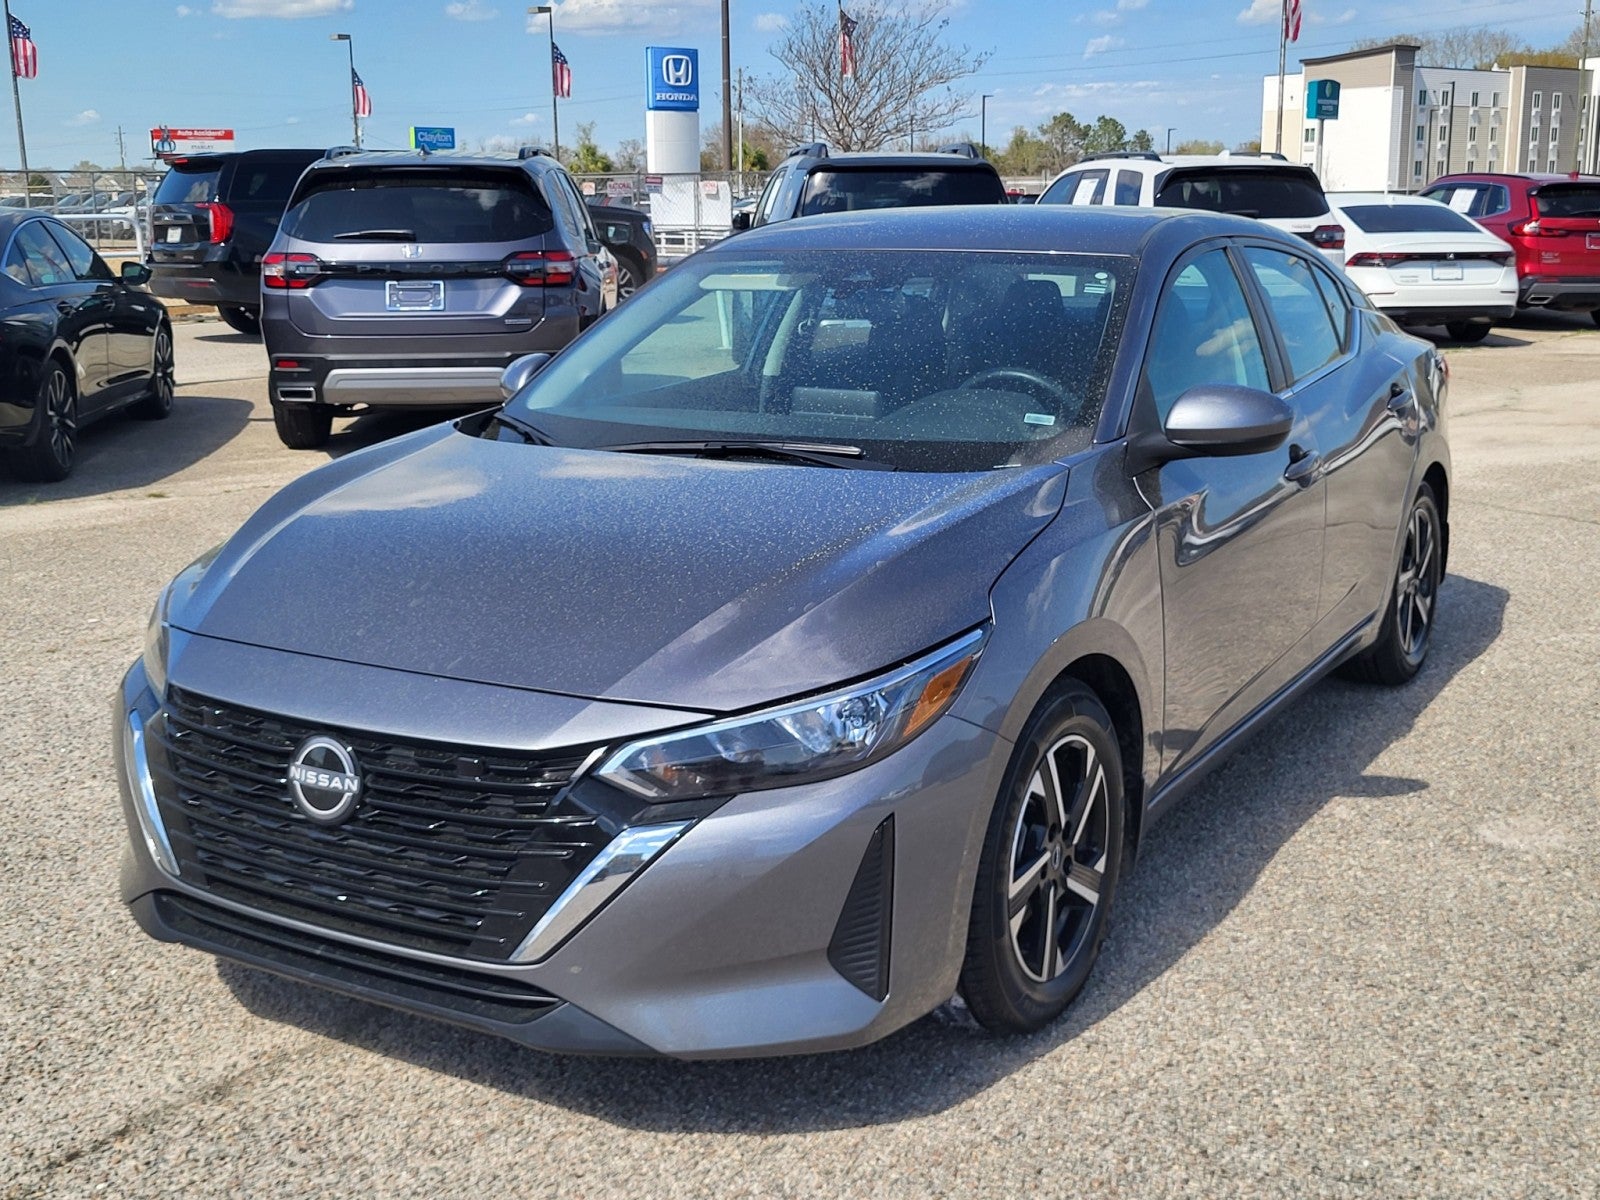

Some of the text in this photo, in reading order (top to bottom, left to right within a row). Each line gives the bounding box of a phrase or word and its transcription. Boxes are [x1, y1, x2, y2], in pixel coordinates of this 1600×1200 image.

[655, 92, 697, 101] HONDA
[418, 131, 452, 143] Clayton
[289, 766, 358, 791] NISSAN
